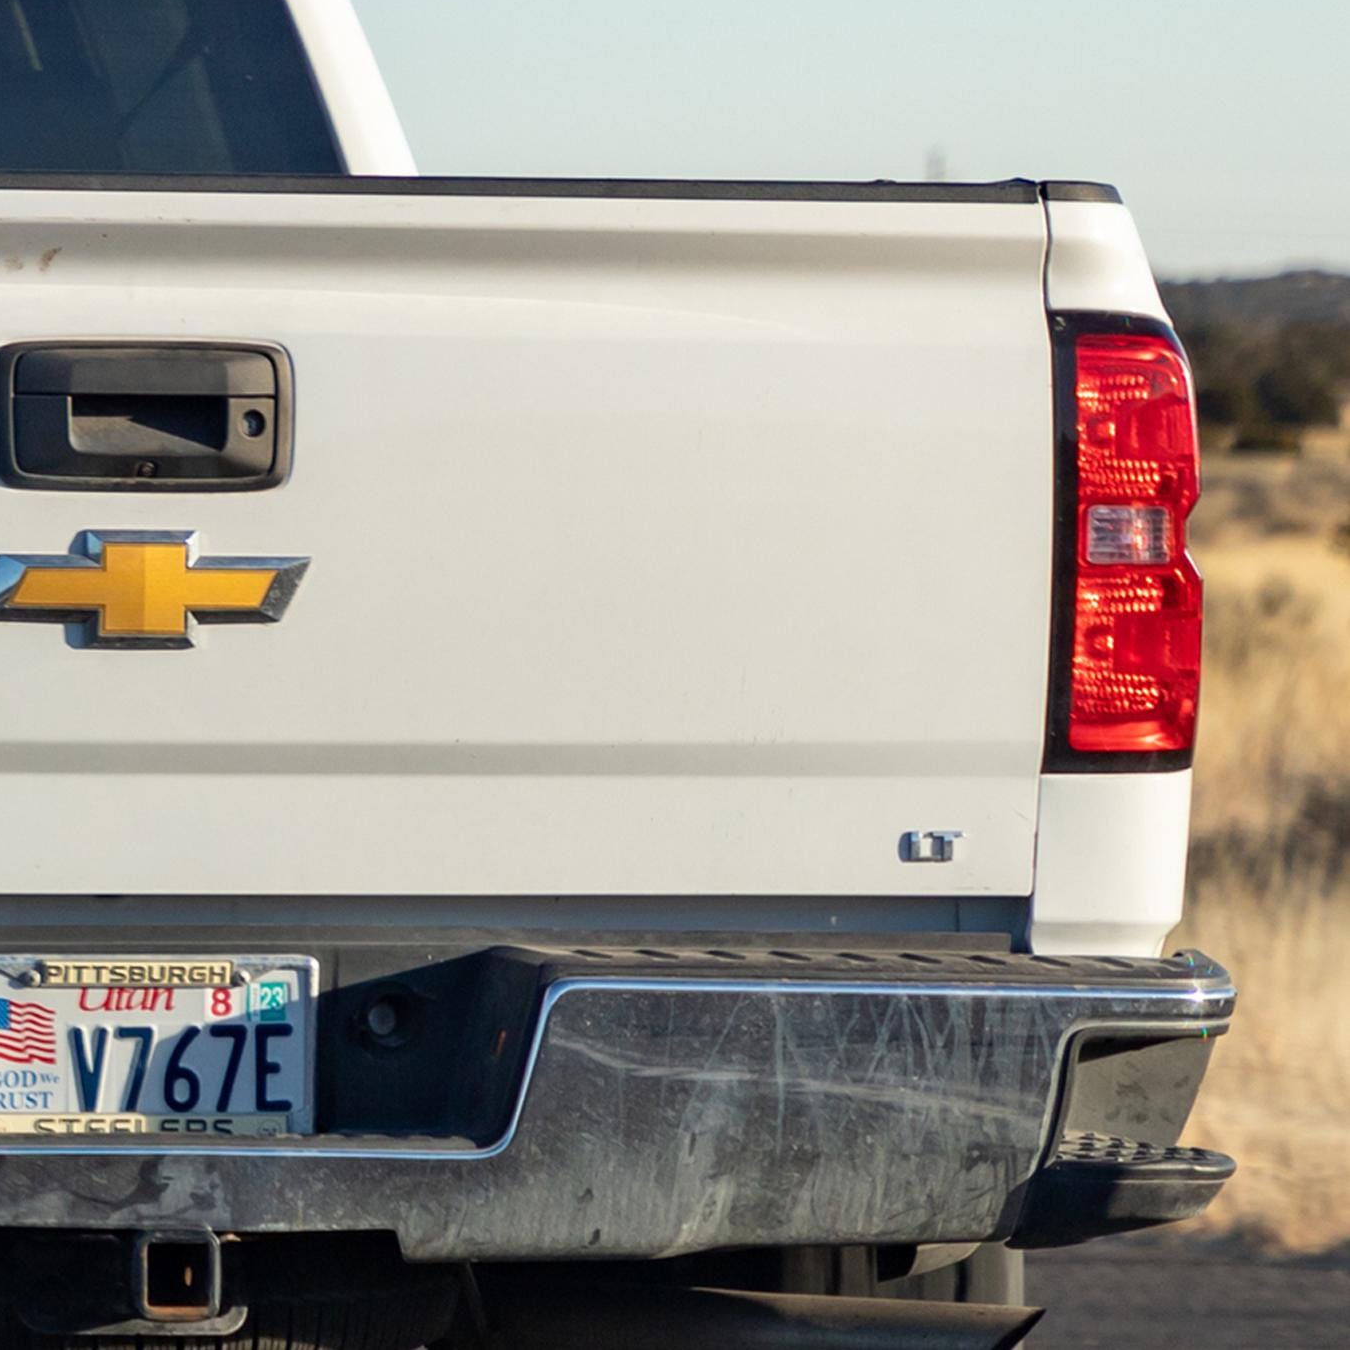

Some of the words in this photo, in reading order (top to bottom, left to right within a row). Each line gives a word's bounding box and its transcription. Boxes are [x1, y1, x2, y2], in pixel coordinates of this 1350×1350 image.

[898, 831, 966, 862] LT
[47, 965, 227, 984] PITTSBURGH
[211, 987, 232, 1017] 8
[260, 986, 285, 1010] 23
[40, 1073, 60, 1083] We
[68, 1024, 293, 1113] V767E
